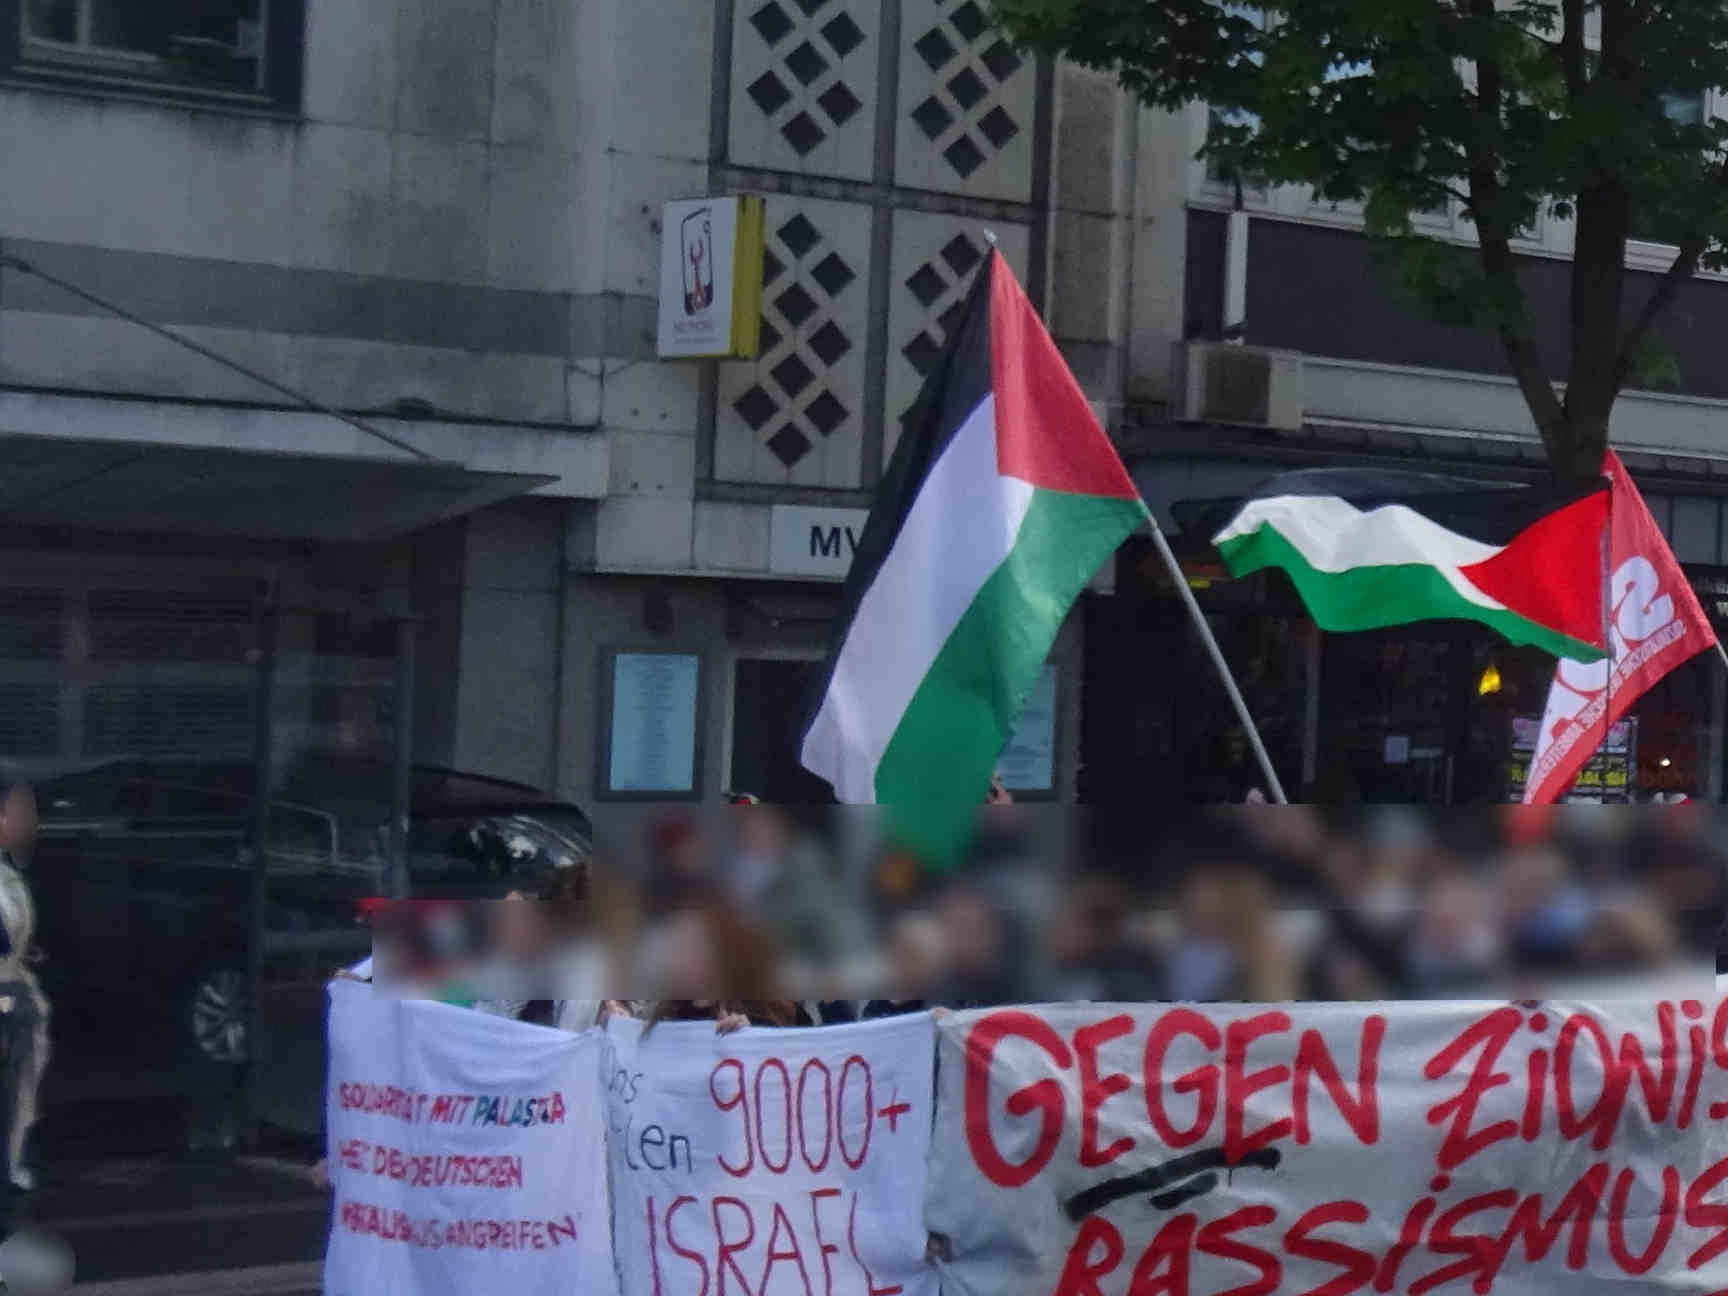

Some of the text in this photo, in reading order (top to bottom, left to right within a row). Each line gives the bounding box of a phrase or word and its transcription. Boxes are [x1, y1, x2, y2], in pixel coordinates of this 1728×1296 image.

[429, 1094, 475, 1125] MIT
[709, 1055, 912, 1178] 9000+
[963, 1009, 1387, 1188] GEGEN
